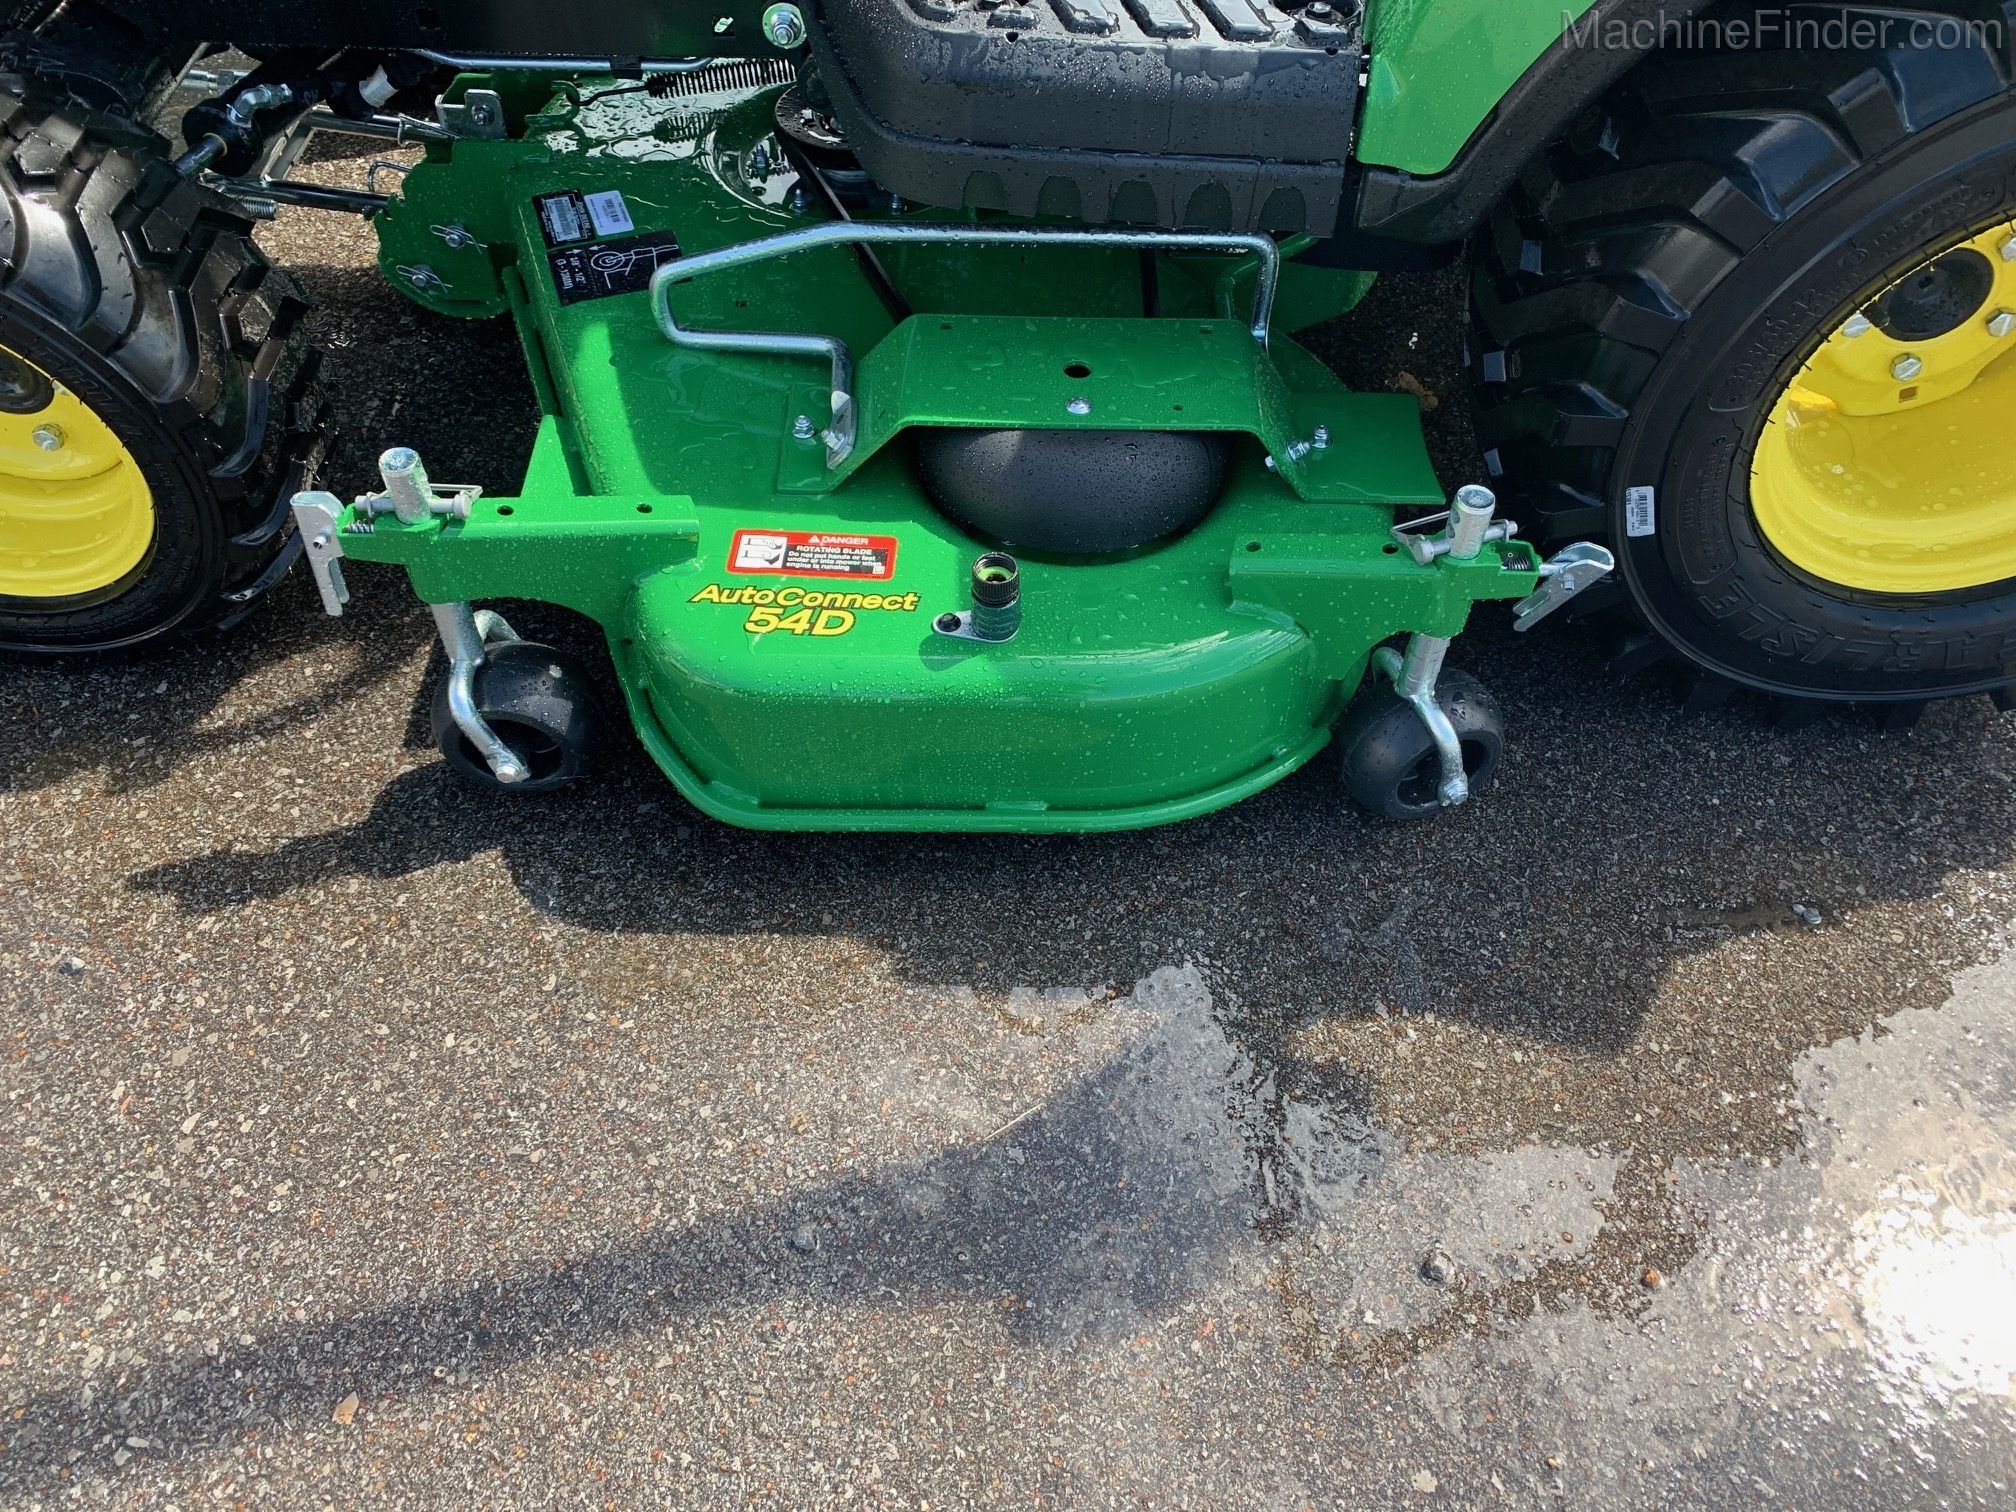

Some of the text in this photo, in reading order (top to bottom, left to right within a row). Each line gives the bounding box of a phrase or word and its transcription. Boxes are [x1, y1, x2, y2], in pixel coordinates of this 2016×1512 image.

[821, 535, 869, 545] DANGER
[796, 545, 872, 555] ROTATING BLADE
[821, 563, 850, 571] running
[687, 583, 922, 612] AutoConnect
[743, 605, 857, 636] 54D
